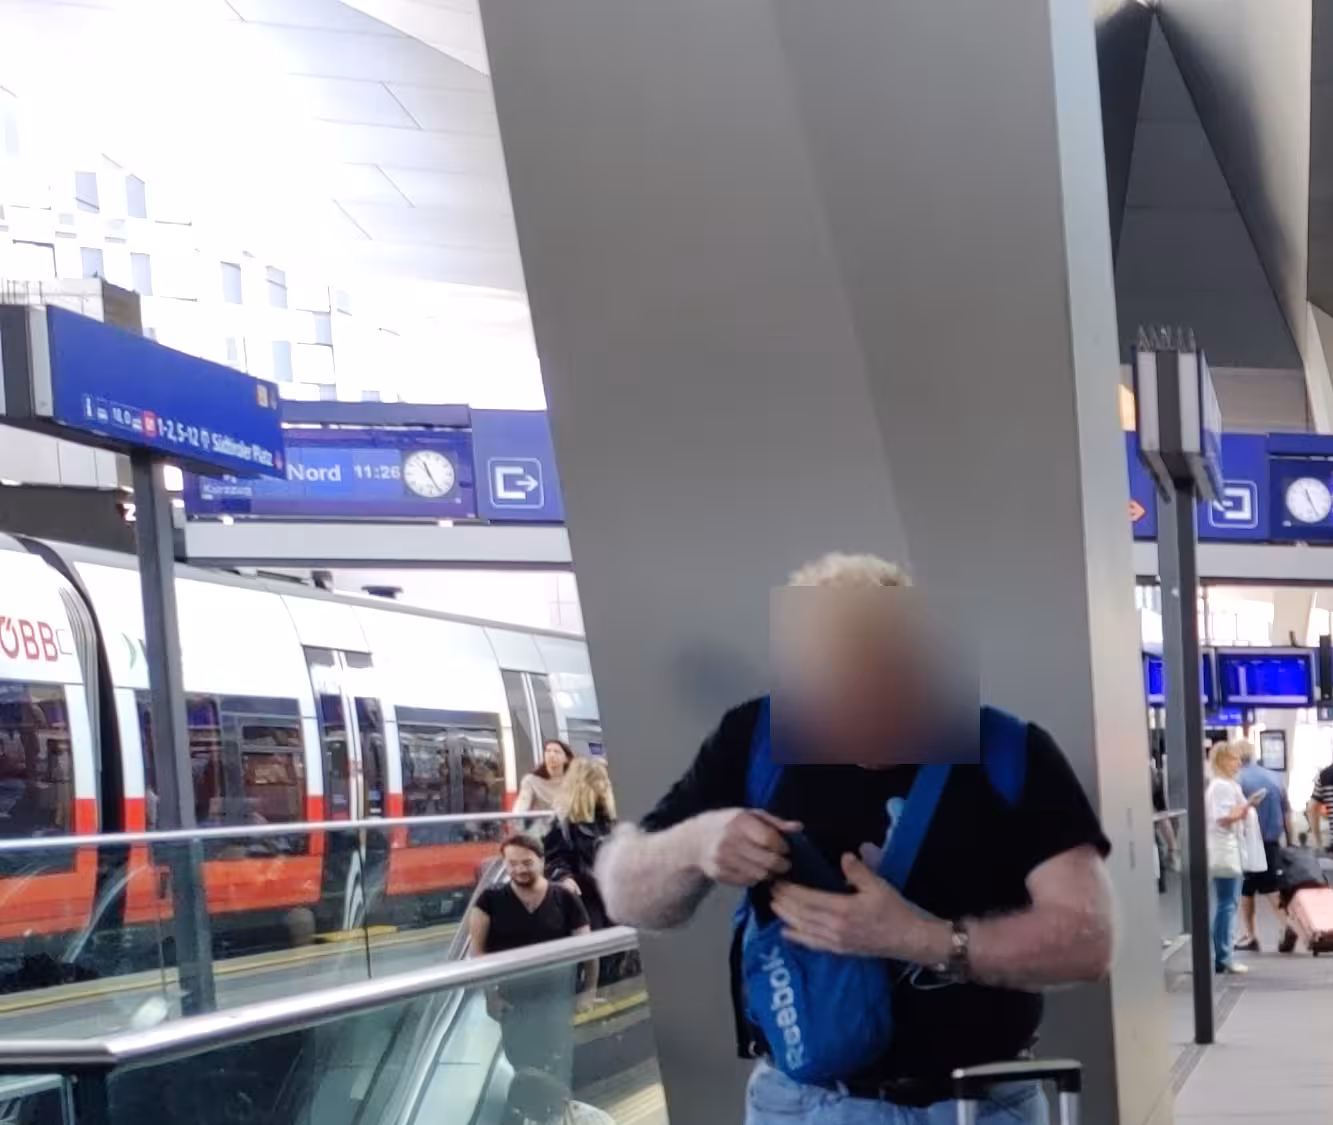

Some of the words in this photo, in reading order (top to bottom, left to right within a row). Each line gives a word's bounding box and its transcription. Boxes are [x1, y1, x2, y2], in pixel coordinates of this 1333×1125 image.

[287, 464, 341, 482] Nord
[354, 464, 400, 480] 11:26
[0, 615, 58, 662] ÖBB
